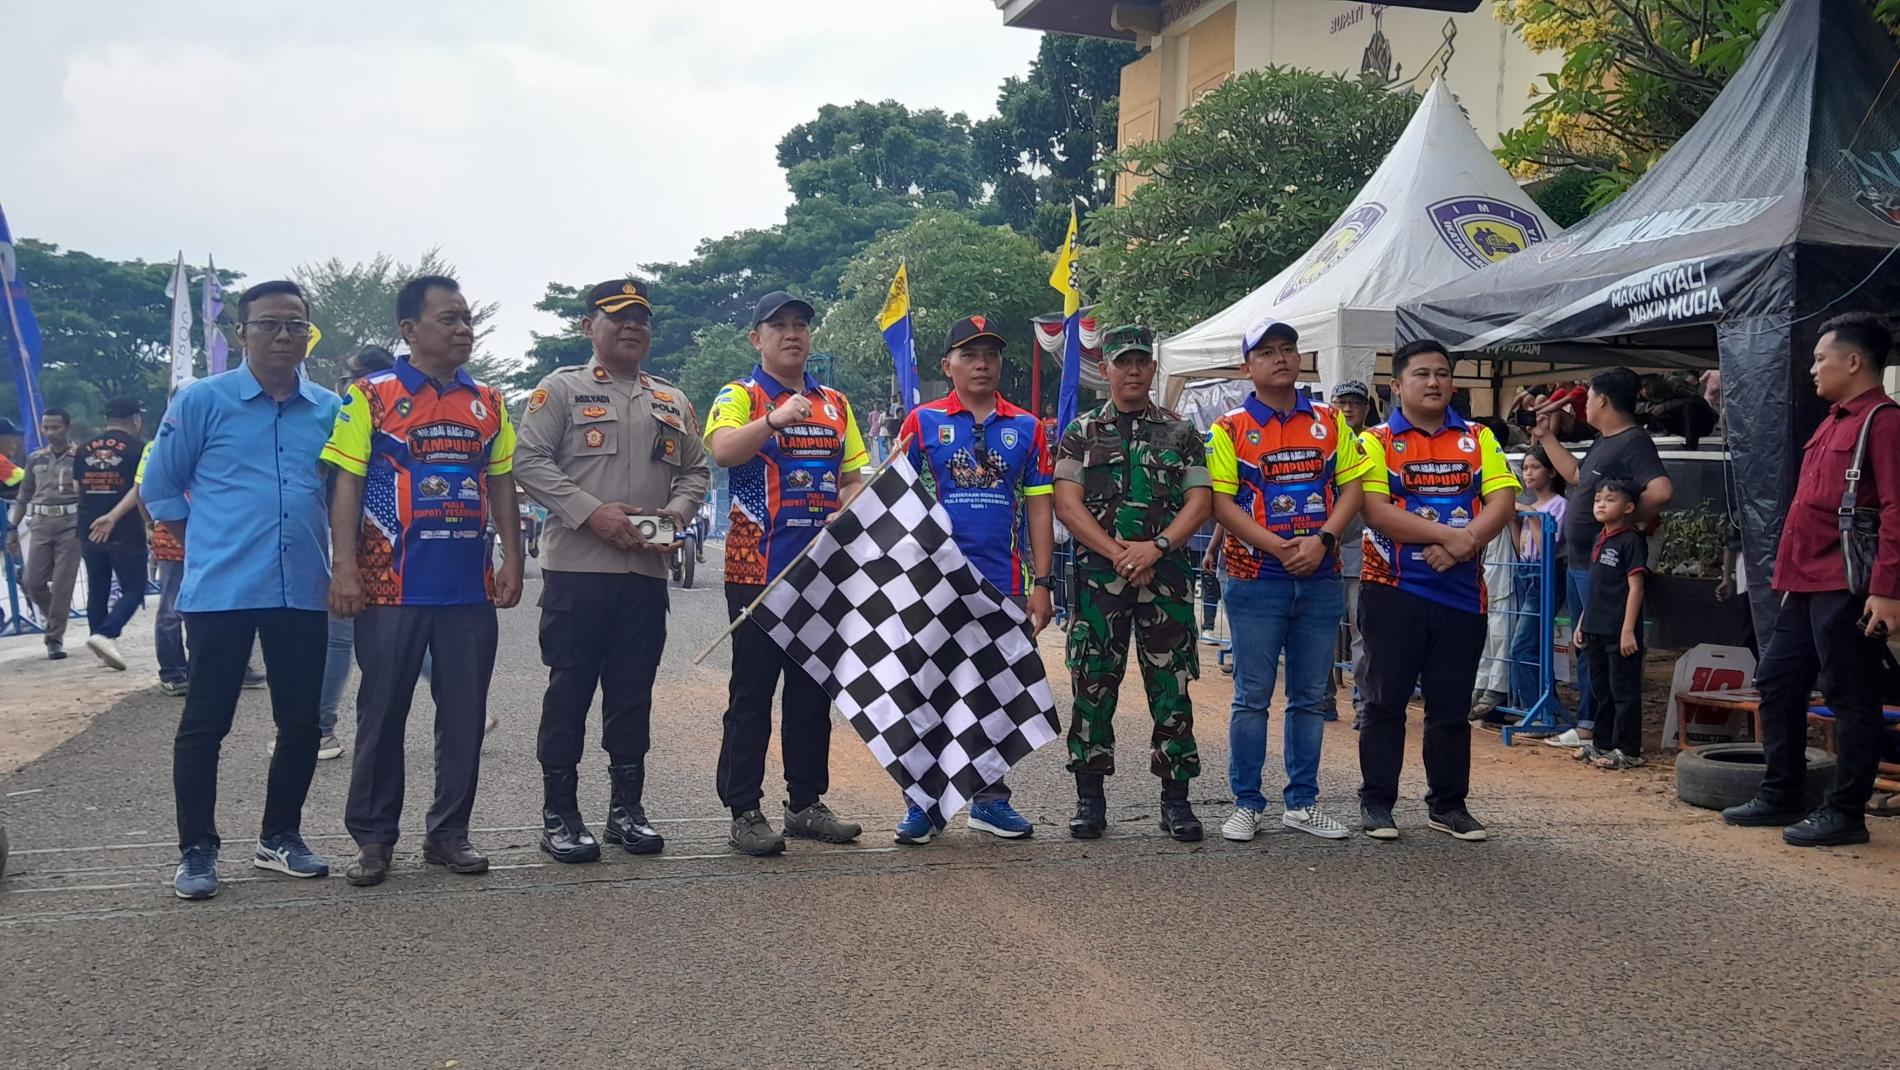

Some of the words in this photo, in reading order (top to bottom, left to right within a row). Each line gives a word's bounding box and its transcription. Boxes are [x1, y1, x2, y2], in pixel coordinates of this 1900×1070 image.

[1443, 221, 1473, 257] IKATAN
[1611, 283, 1651, 309] MAKIN
[1652, 262, 1707, 298] NYALI
[1628, 298, 1667, 323] MAKIN
[1668, 287, 1723, 321] MUDA
[575, 395, 610, 403] MULYADI
[86, 438, 126, 451] IMOS
[412, 439, 481, 453] LAMPUNG
[780, 437, 839, 449] LAMPUNG
[1264, 459, 1323, 476] LAMPUNG
[1405, 472, 1469, 486] LAMPUNG
